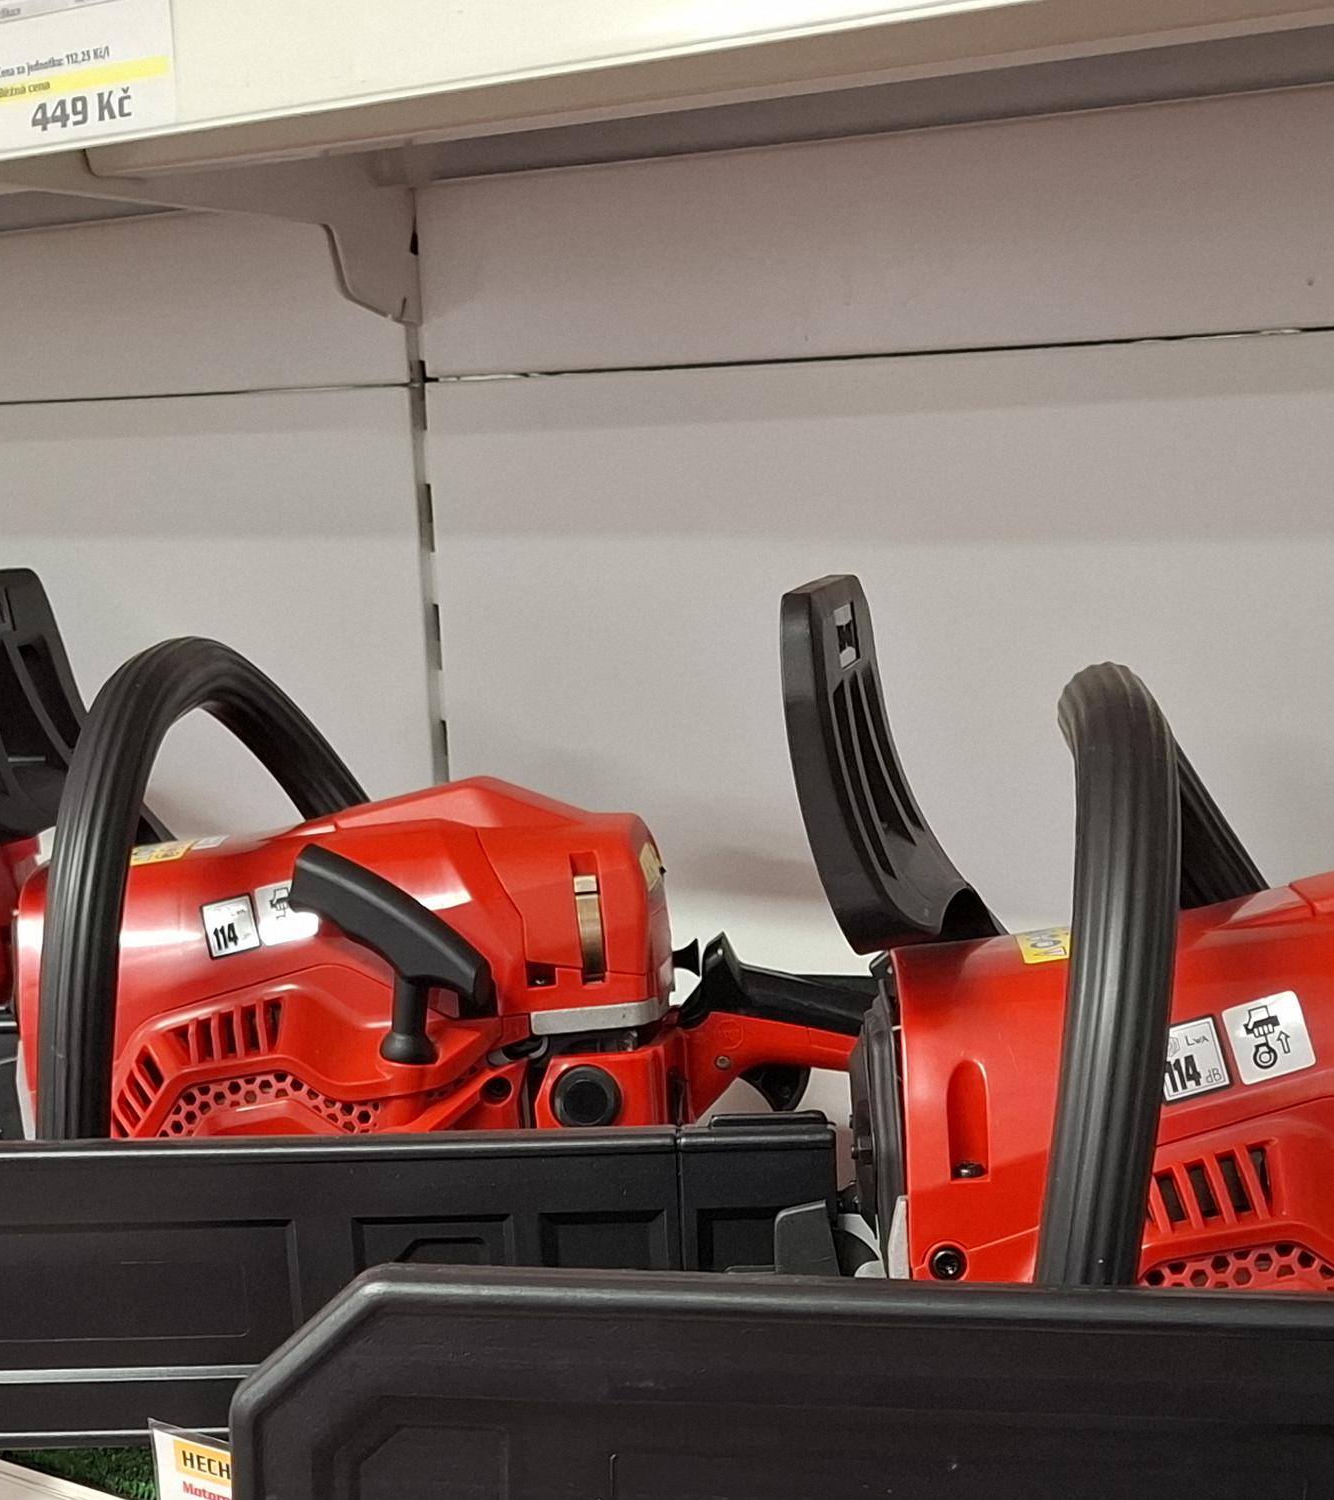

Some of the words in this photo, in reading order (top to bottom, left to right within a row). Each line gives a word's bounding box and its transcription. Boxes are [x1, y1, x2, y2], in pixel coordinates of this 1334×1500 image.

[28, 81, 51, 93] cena
[31, 95, 89, 132] 449
[97, 86, 133, 122] Kč
[213, 922, 239, 951] 114
[1166, 1054, 1202, 1093] 114
[1205, 1068, 1223, 1084] dB
[182, 1450, 231, 1480] HECH
